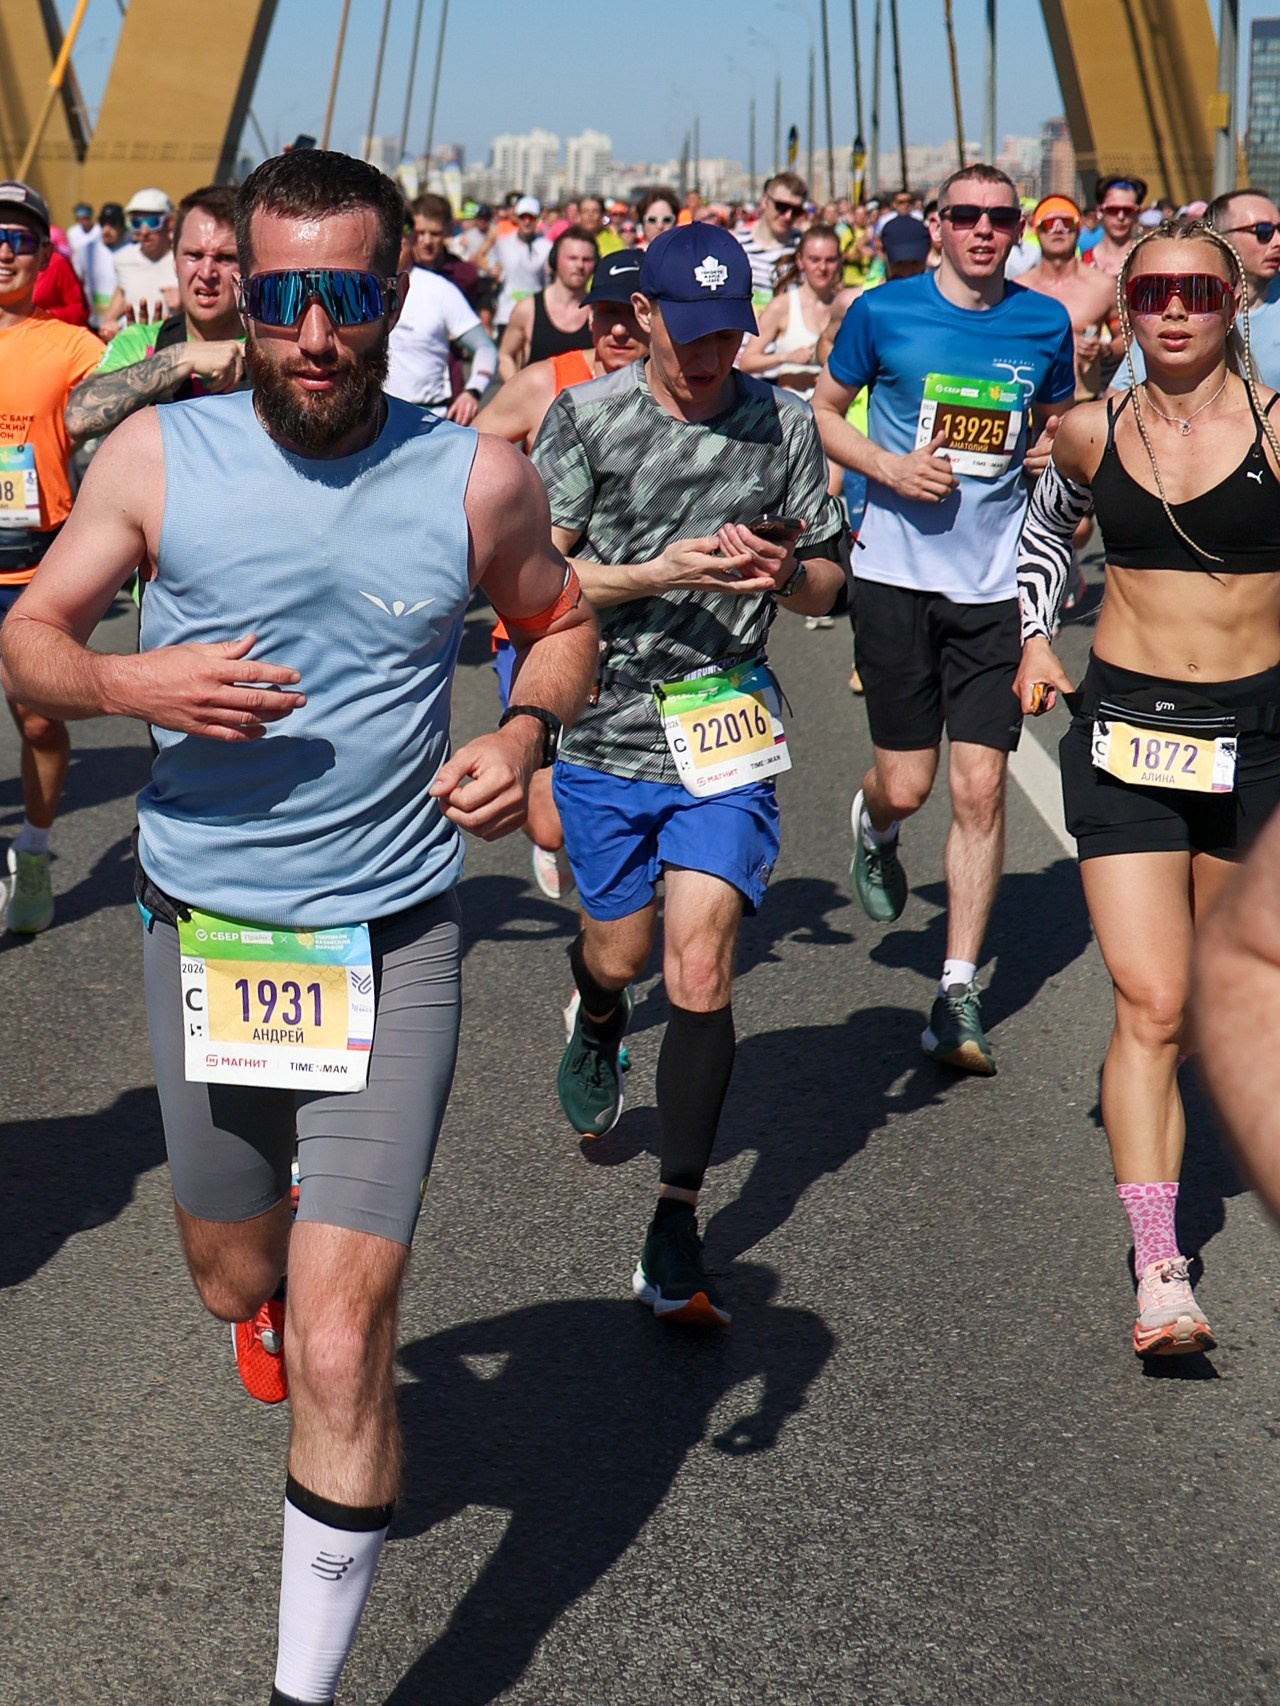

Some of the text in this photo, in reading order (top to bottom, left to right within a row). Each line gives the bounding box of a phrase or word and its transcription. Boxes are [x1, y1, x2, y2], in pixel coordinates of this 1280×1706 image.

[942, 413, 1005, 446] 13925
[949, 440, 989, 452] АНАТОЛИЙ
[692, 704, 767, 753] 22016
[1129, 737, 1199, 775] 1872
[1141, 771, 1175, 784] АЛИНА
[210, 931, 239, 941] СБЕР
[182, 964, 204, 974] 2026
[235, 979, 321, 1027] 1931
[252, 1028, 304, 1043] АНДРЕЙ
[221, 1057, 267, 1068] МАГНИТ
